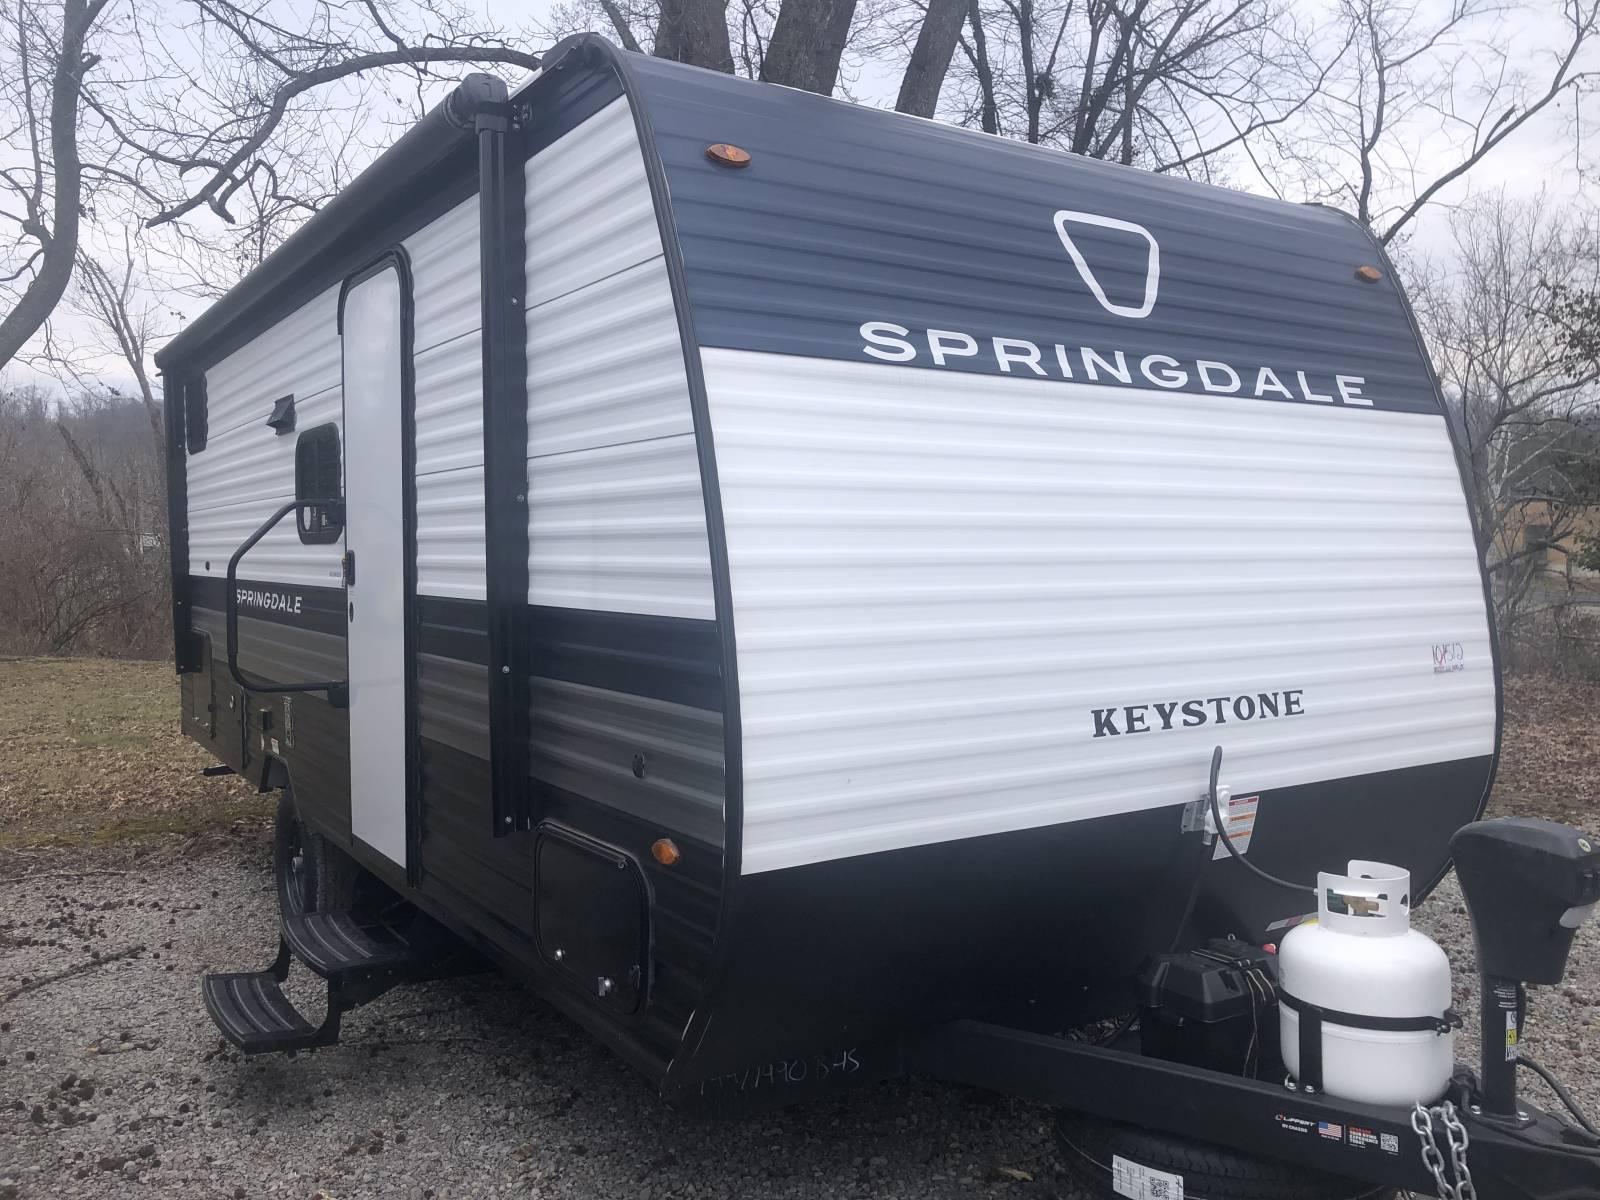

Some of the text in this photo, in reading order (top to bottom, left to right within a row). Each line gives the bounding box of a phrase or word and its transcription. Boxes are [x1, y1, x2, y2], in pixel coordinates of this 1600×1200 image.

[859, 321, 1374, 407] SPRINGDALE
[236, 588, 303, 614] SPRINGDALE
[1091, 690, 1305, 738] KEYSTONE
